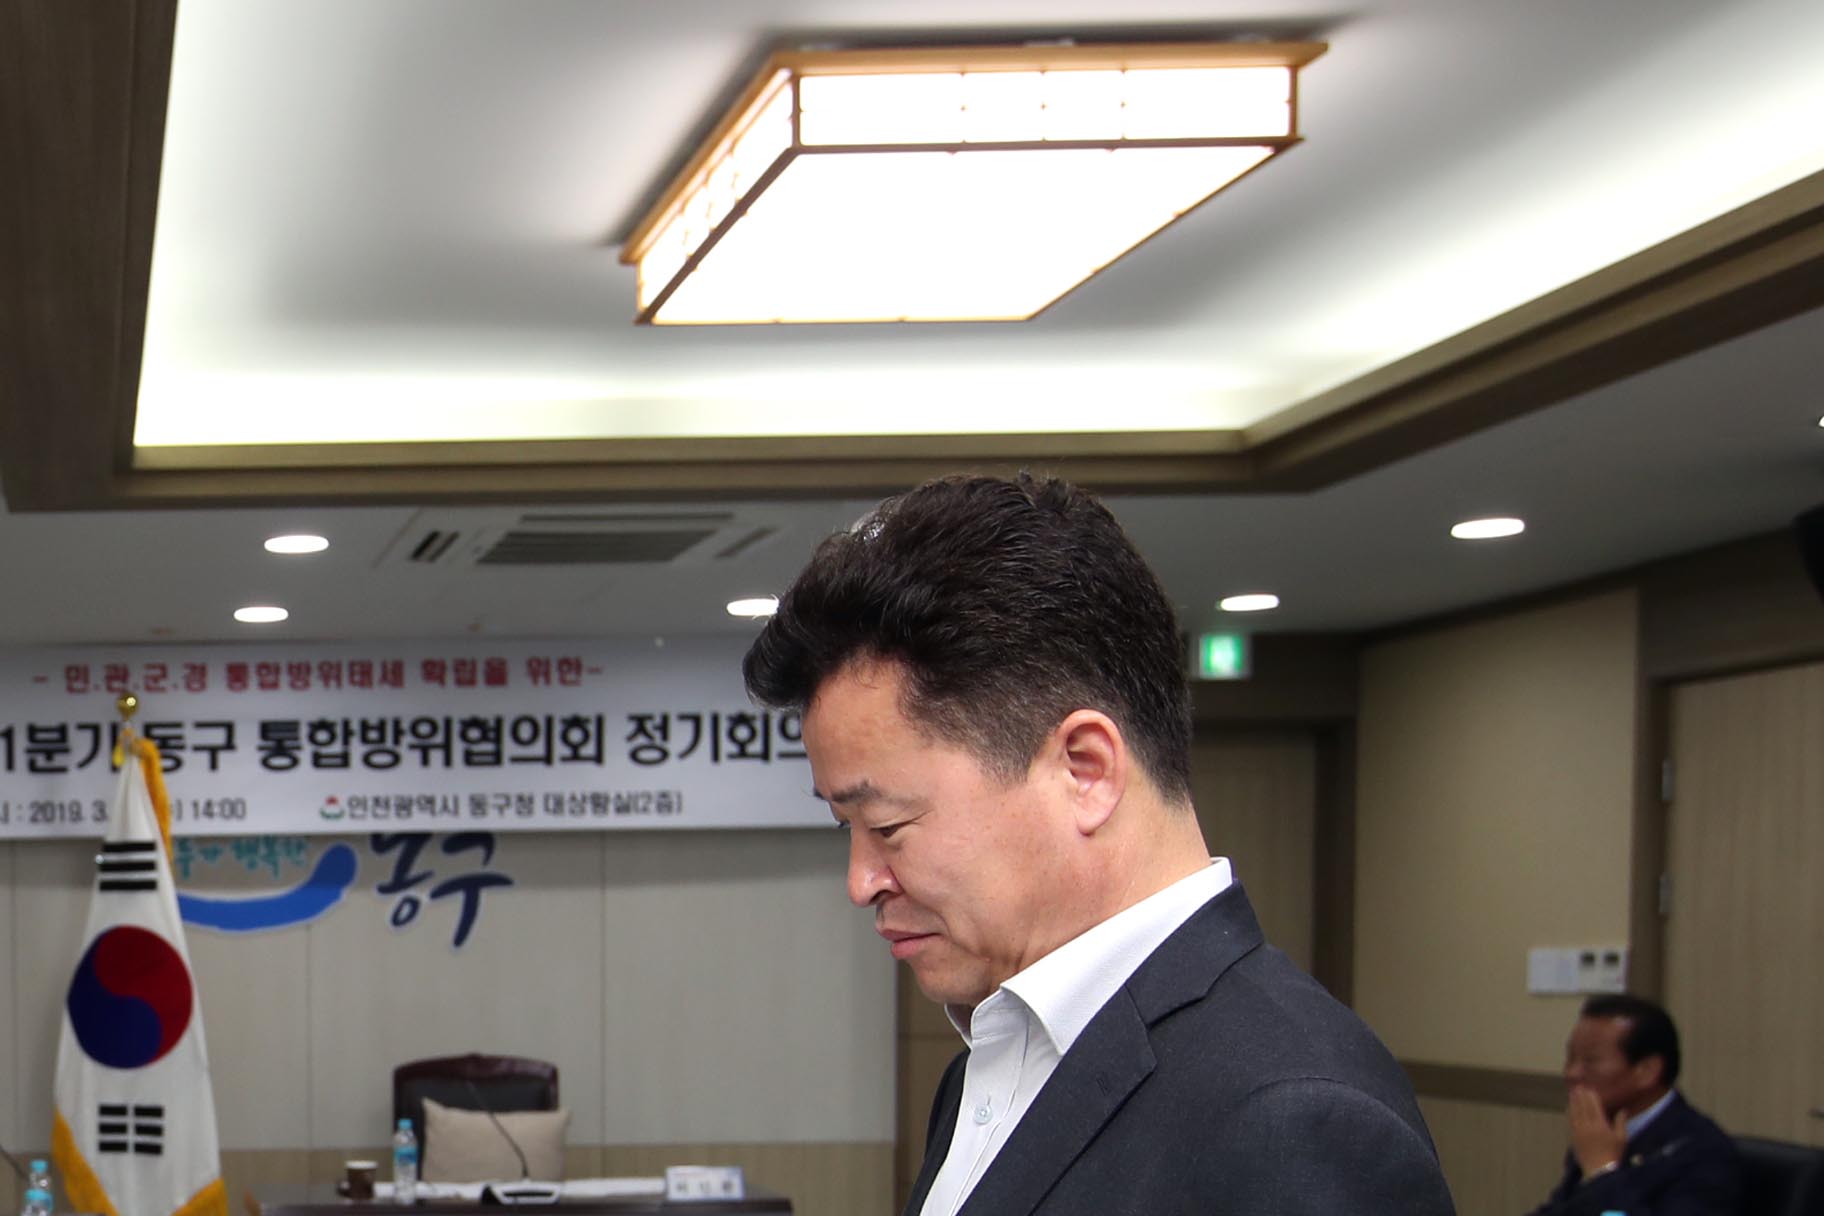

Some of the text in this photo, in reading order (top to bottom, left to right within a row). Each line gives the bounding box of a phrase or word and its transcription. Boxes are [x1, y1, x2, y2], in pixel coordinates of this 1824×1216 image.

[143, 720, 237, 773] 동구
[257, 711, 606, 771] 통합방위협의회
[191, 798, 248, 821] 14:00
[347, 794, 460, 820] 인천광역시
[469, 792, 534, 818] 동구청
